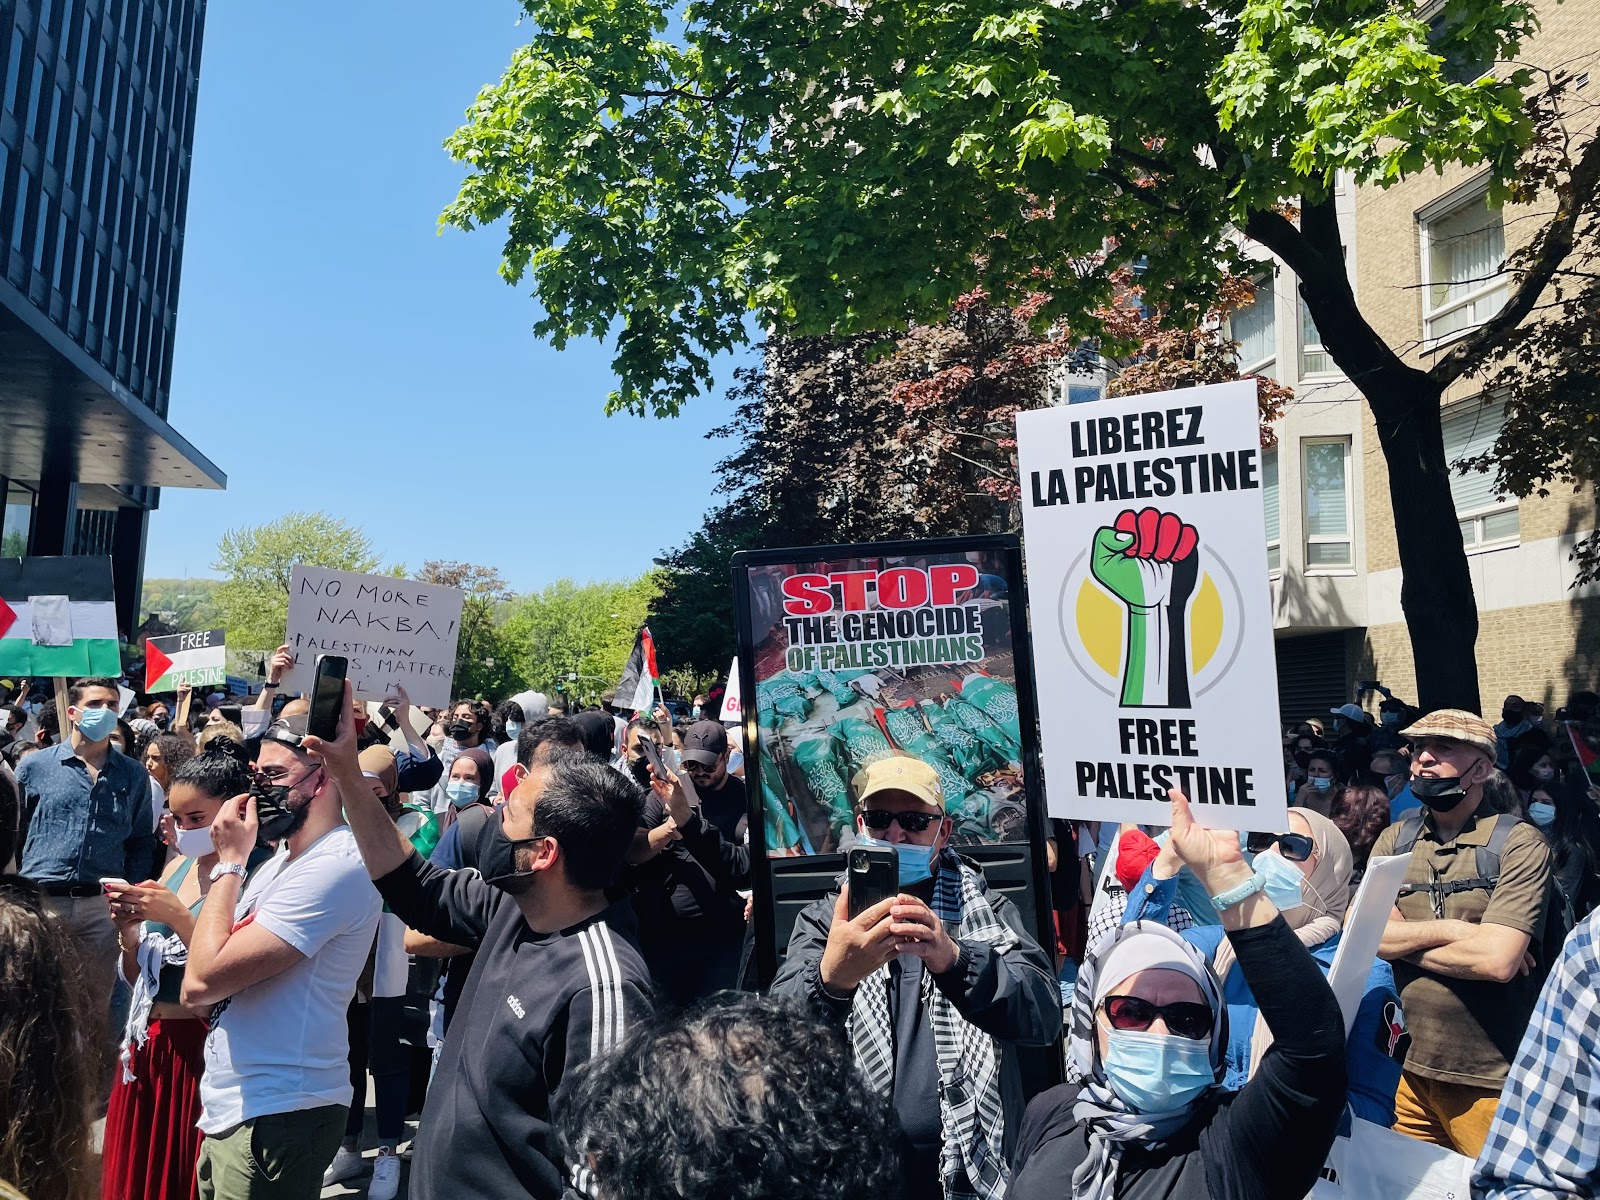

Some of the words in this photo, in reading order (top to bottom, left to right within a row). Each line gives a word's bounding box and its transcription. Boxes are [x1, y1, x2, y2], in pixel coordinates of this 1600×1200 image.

[1070, 405, 1205, 458] LIBEREZ
[1030, 468, 1070, 508] LA
[1074, 449, 1259, 504] PALESTINE
[300, 577, 342, 597] NO
[356, 583, 429, 608] MORE
[782, 564, 979, 616] STOP
[180, 630, 211, 651] FREE
[316, 607, 456, 642] NAKBA!
[785, 615, 838, 646] THE
[842, 605, 982, 642] GENOCIDE
[294, 652, 363, 671] LIS
[788, 646, 818, 672] OF
[820, 636, 983, 670] PALESTINIANS
[1118, 717, 1199, 757] FREE
[1075, 760, 1257, 807] PALESTINE
